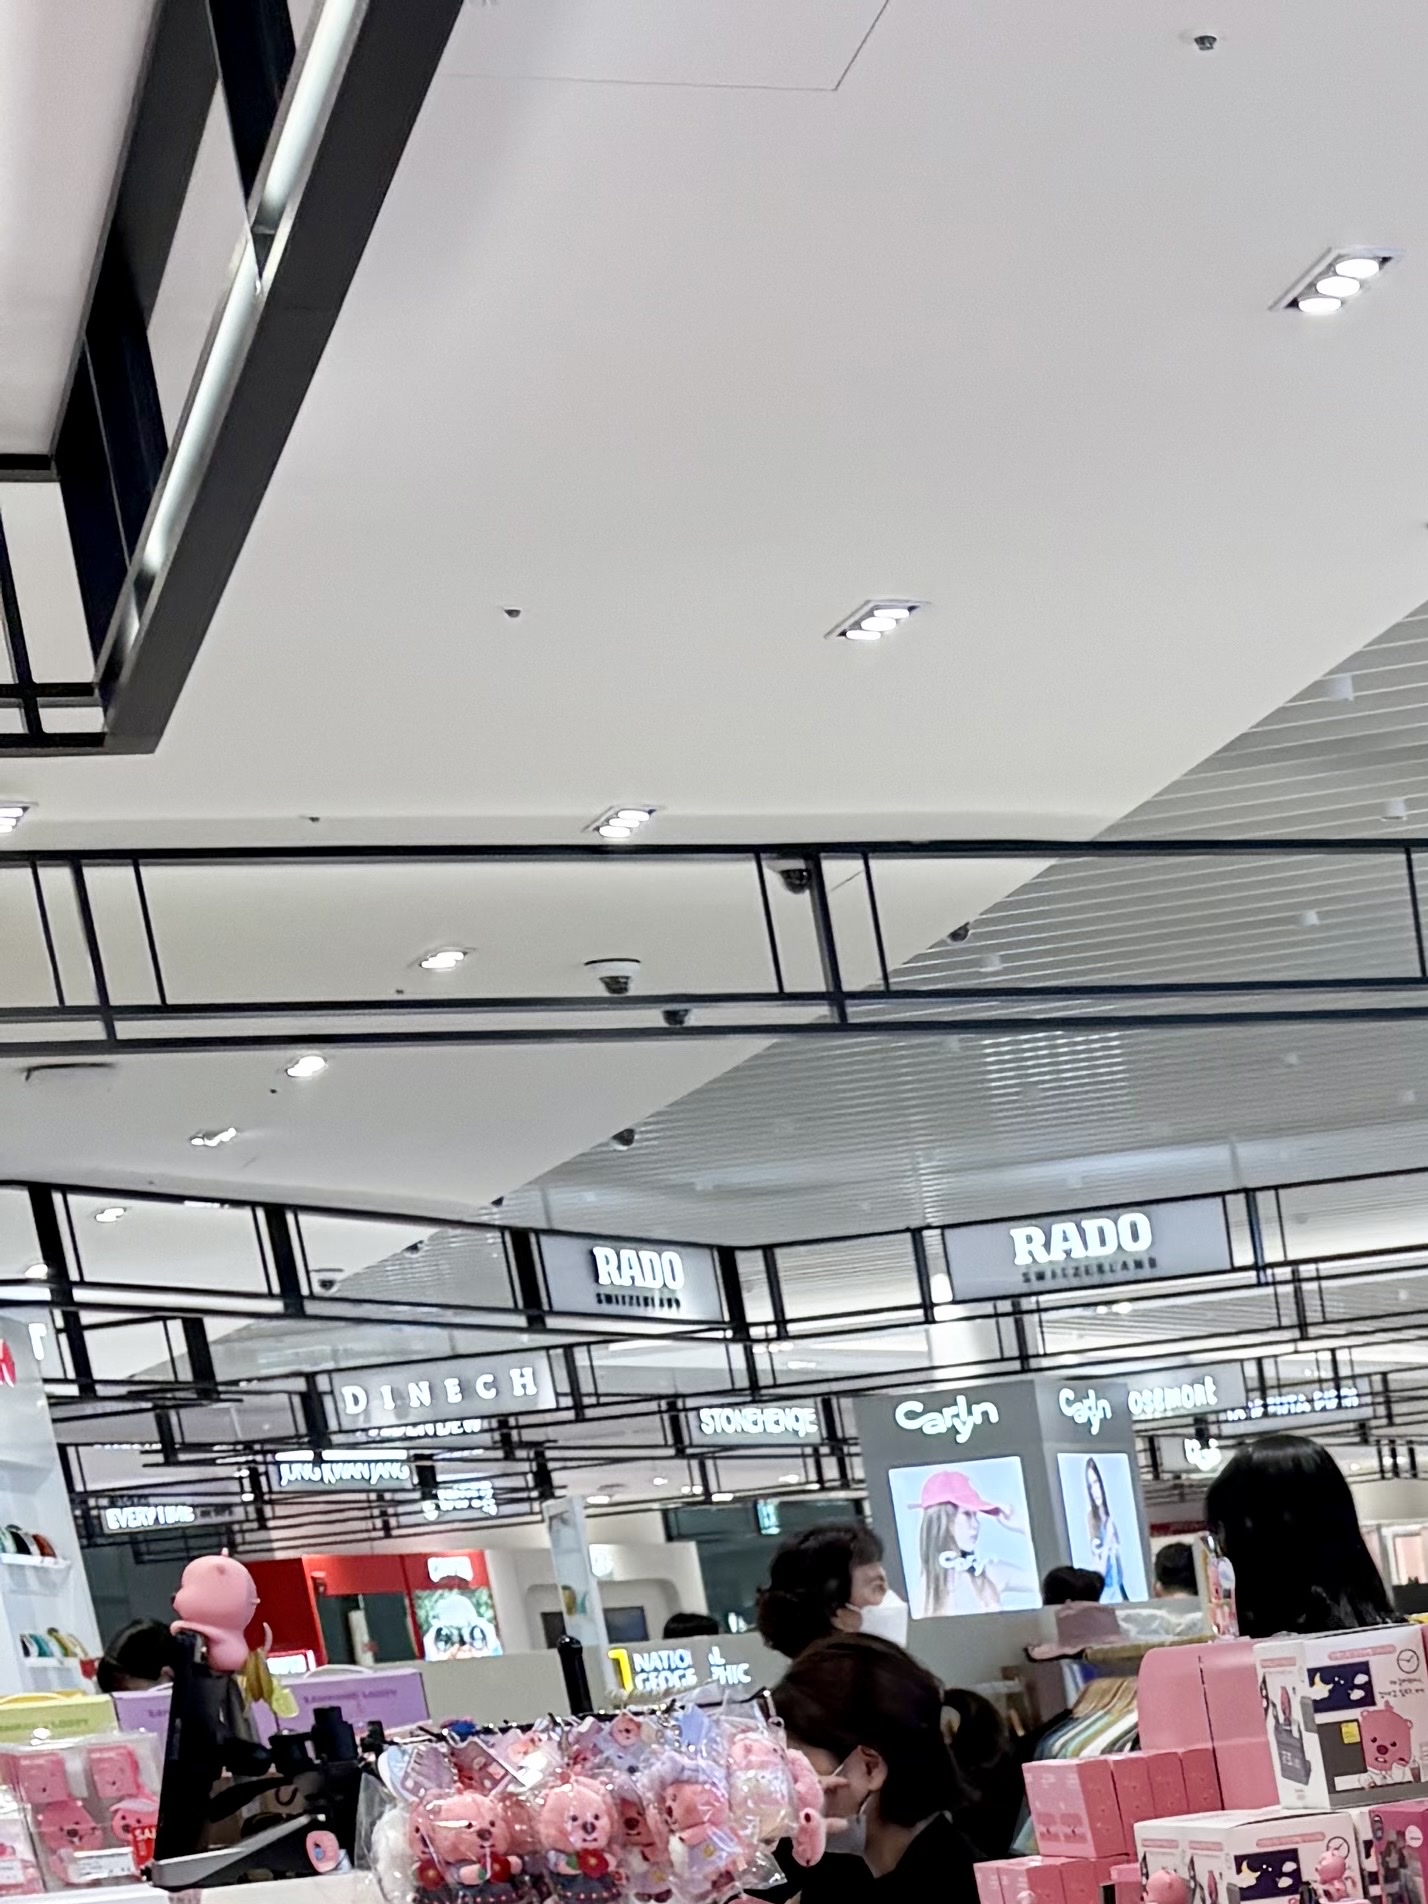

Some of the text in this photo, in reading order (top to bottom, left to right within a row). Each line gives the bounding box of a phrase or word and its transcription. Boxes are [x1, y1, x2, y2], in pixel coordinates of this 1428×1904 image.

[1011, 1213, 1153, 1264] RADO
[592, 1247, 684, 1290] RADO
[699, 1406, 819, 1437] STONEHENGE
[895, 1396, 999, 1443] Carlyn
